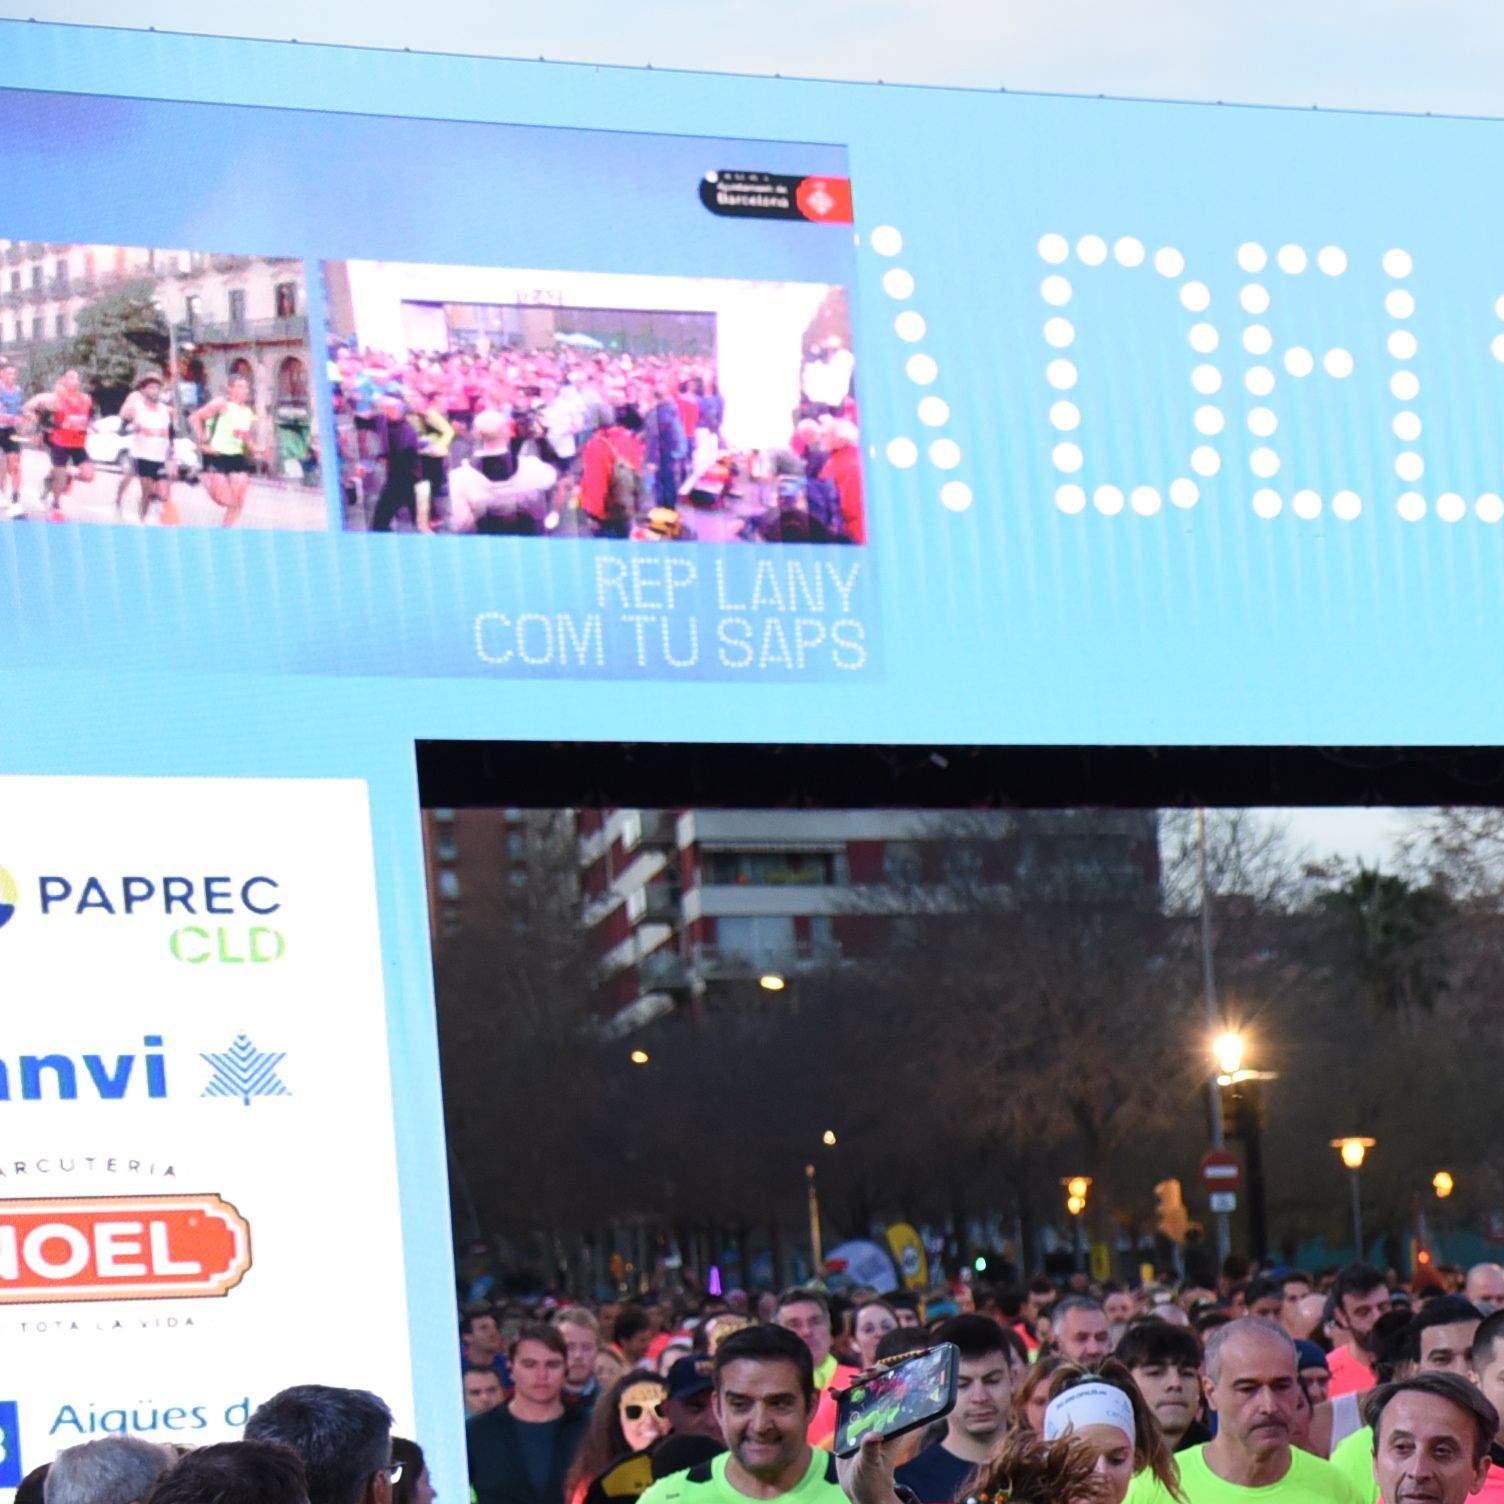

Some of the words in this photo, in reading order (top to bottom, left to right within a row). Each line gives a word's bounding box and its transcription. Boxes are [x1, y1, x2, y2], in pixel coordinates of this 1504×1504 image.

[596, 555, 698, 609] REP
[715, 558, 861, 613] LANY
[474, 611, 605, 666] COM
[621, 614, 700, 668] TU
[716, 617, 868, 671] SAPS
[38, 875, 281, 915] PAPREC
[169, 926, 287, 964] CLD
[224, 1396, 251, 1428] d
